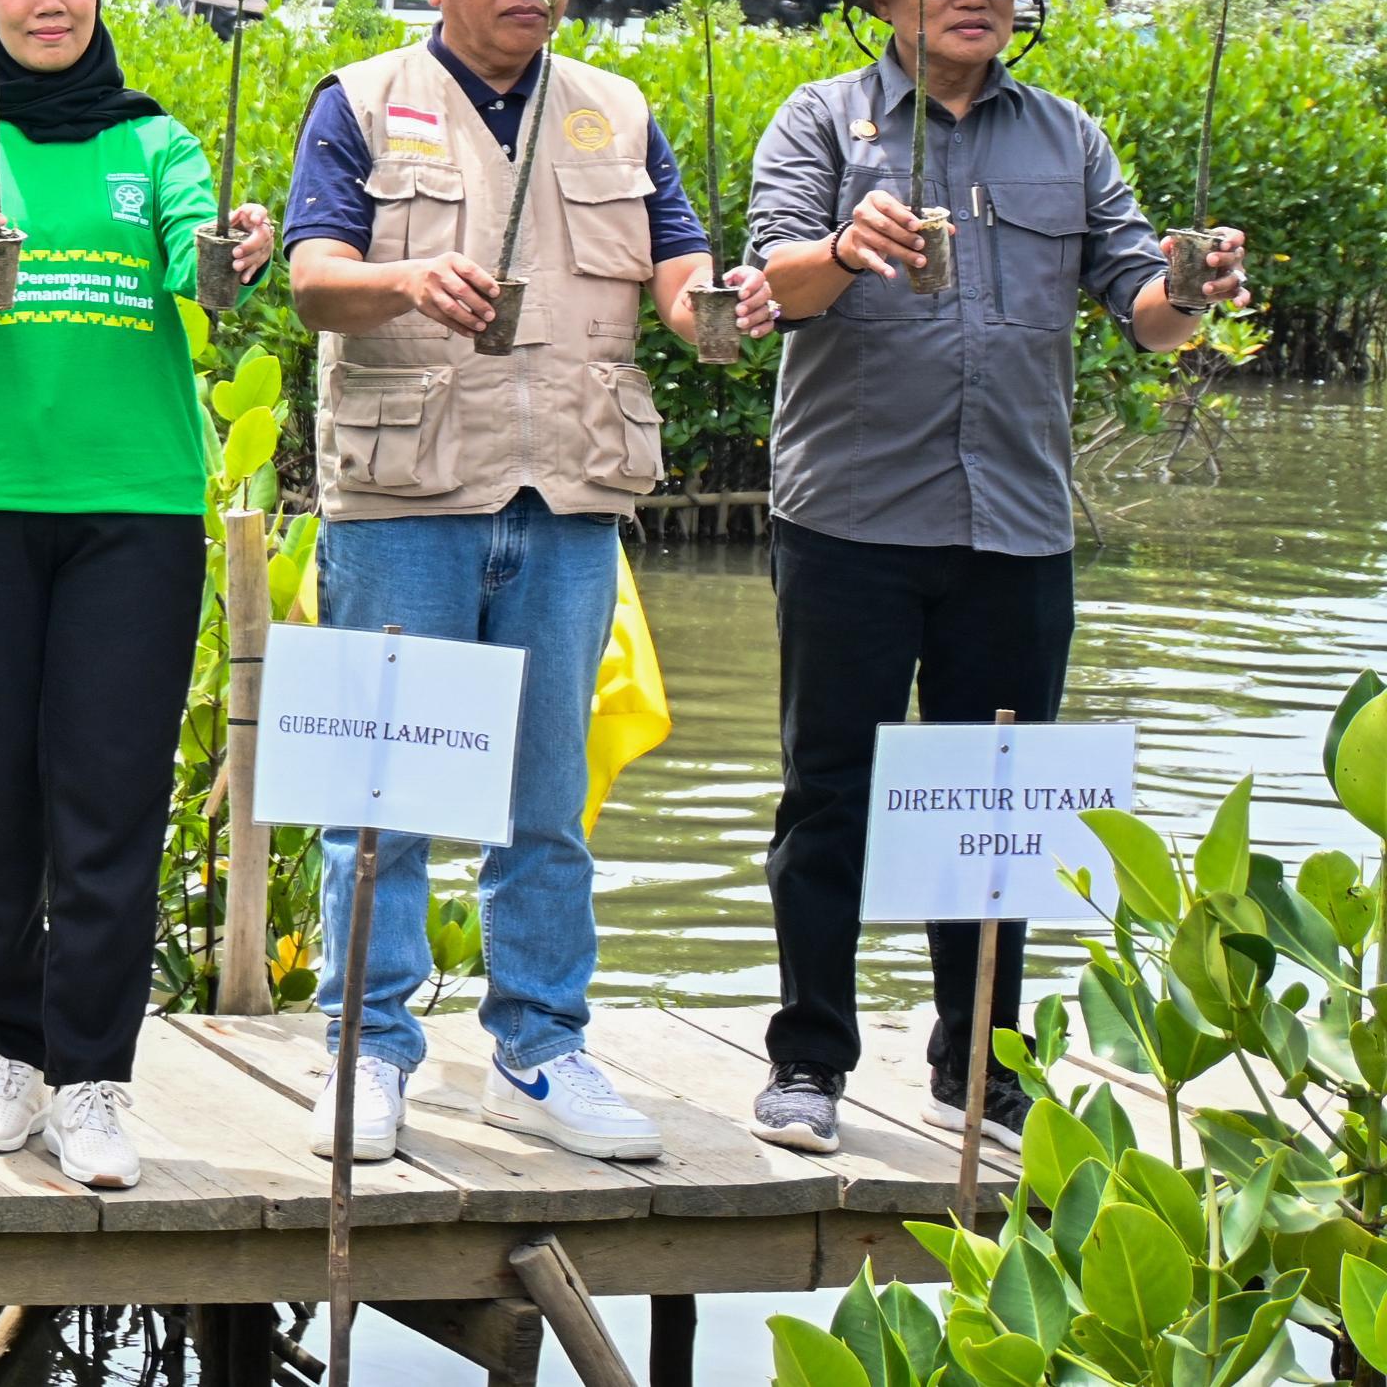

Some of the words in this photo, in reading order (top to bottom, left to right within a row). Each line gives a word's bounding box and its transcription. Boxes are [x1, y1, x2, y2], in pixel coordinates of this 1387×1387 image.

[17, 271, 111, 287] Perempuan
[115, 274, 138, 290] NU
[113, 291, 154, 310] Umat
[279, 714, 377, 740] GUBERNUR
[383, 721, 490, 752] LAMPUNG
[887, 788, 1014, 811] DIREKTUR
[1024, 787, 1116, 810] UTAMA
[959, 833, 1042, 856] BPDLH
